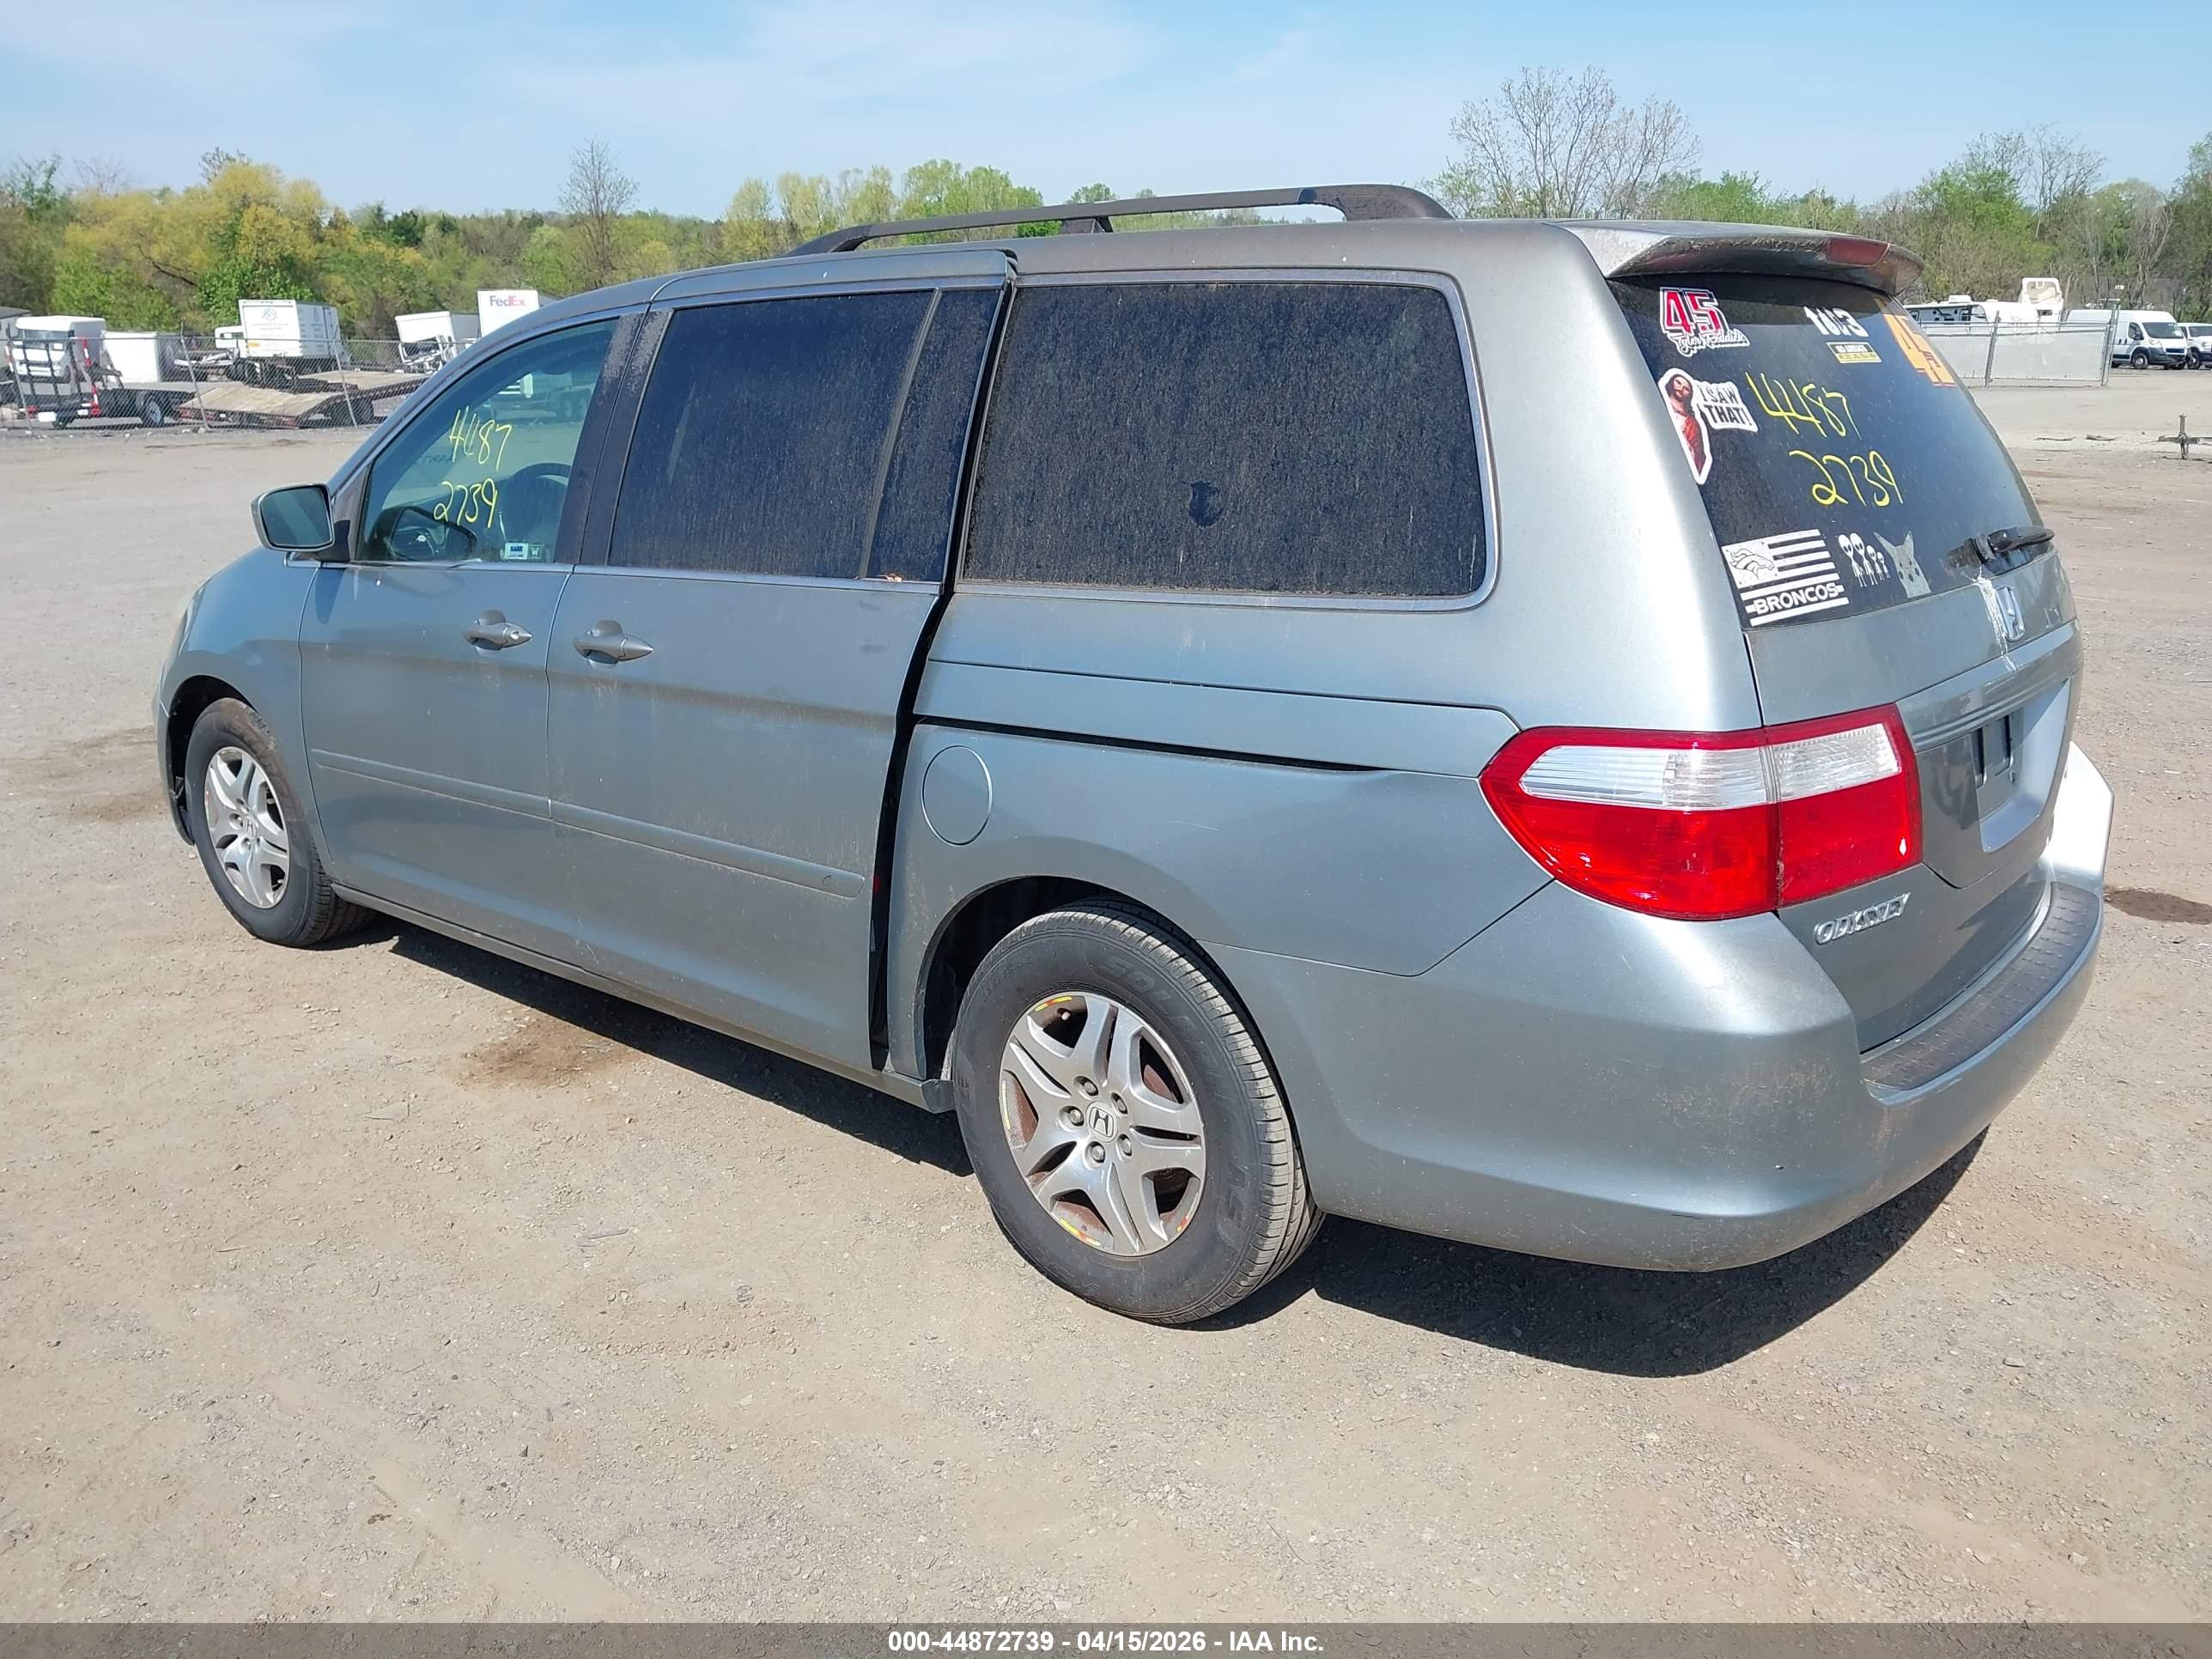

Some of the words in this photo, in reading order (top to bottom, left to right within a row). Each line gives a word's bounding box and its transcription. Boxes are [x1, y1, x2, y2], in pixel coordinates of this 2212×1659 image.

[489, 295, 526, 307] FedEx
[1662, 288, 1726, 336] 45
[1669, 333, 1704, 354] Tyler
[1697, 385, 1708, 402] I
[1706, 386, 1739, 404] SAW
[1745, 372, 1862, 441] 4487
[1703, 404, 1753, 426] THAT!
[1789, 450, 1904, 507] 2739
[434, 477, 498, 529] 2739
[1753, 582, 1839, 615] BRONCOS
